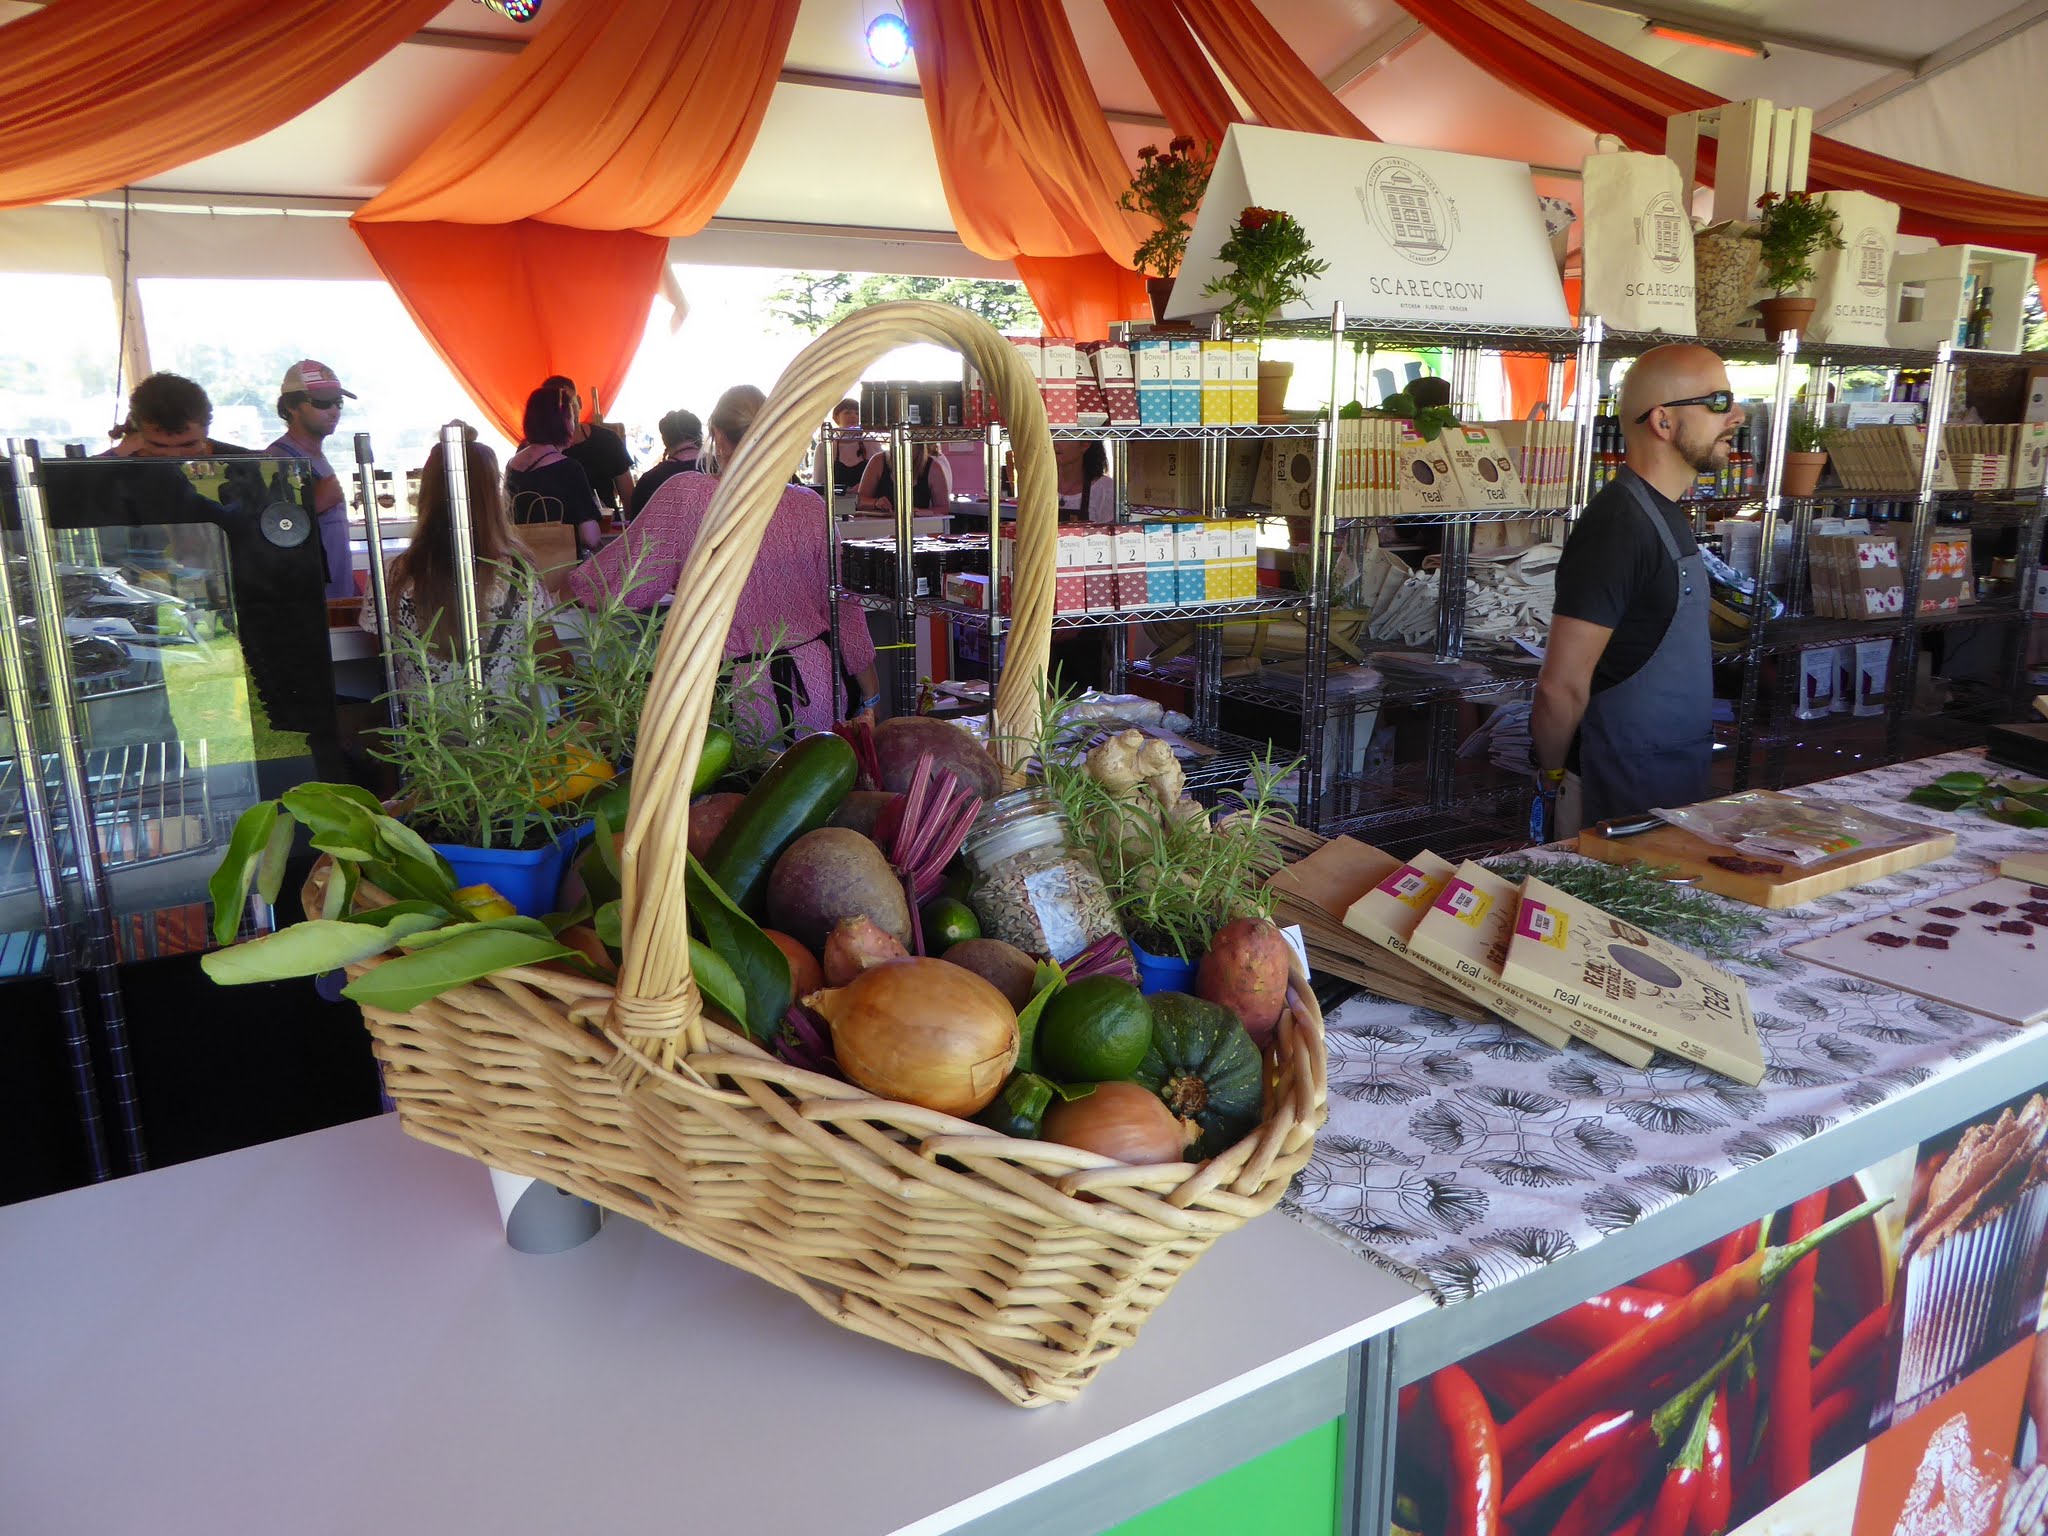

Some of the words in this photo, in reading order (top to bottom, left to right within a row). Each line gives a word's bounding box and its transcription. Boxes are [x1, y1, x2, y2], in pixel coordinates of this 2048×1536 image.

[1369, 276, 1484, 300] SCARECROW
[1625, 282, 1695, 298] SCARECROW
[1834, 304, 1888, 320] SCARECRO
[1058, 364, 1063, 377] 1
[1116, 364, 1123, 376] 2
[1153, 365, 1160, 378] 3
[1183, 365, 1191, 378] 3
[1216, 366, 1221, 379] 1
[1244, 366, 1249, 379] 1
[1168, 453, 1177, 477] real
[1277, 453, 1287, 481] real
[1421, 489, 1444, 503] real
[1485, 487, 1507, 500] real
[1128, 549, 1136, 561] 2
[1157, 547, 1165, 560] 3
[1190, 546, 1197, 559] 3
[1216, 545, 1221, 557] 1
[1244, 543, 1248, 555] 1
[1067, 554, 1072, 565] 1
[1096, 551, 1103, 563] 2
[1411, 951, 1451, 977] VEGETABLE
[1450, 973, 1476, 992] WRAPS
[1582, 959, 1608, 989] REAL
[1455, 959, 1482, 979] real
[1482, 973, 1525, 1000] VEGETABLE
[1526, 997, 1553, 1014] WRAPS
[1605, 963, 1622, 1001] VEGETABLE
[1622, 976, 1637, 1000] WRAPS
[1693, 978, 1733, 1020] real
[1553, 987, 1581, 1007] real
[1582, 1001, 1629, 1025] VEGETABLE
[1629, 1021, 1658, 1037] WRAPS
